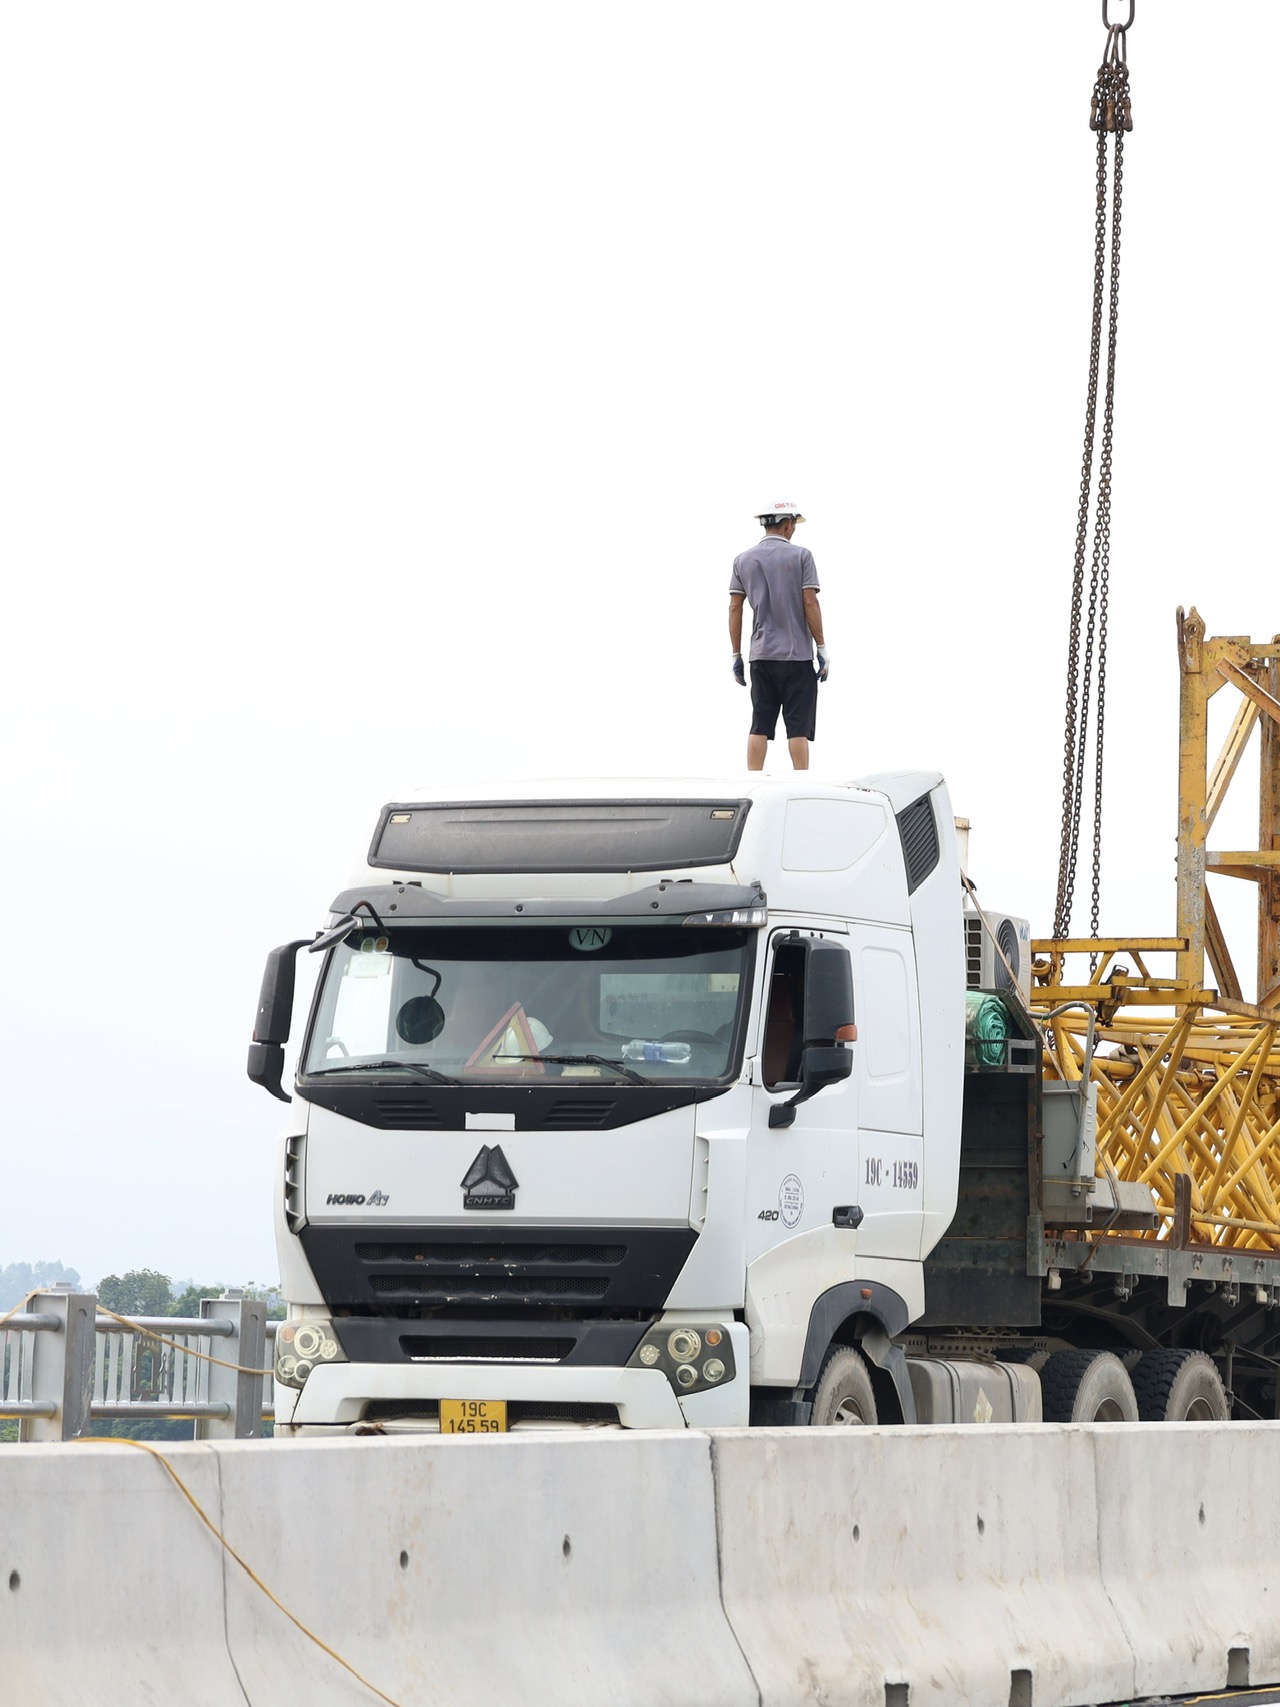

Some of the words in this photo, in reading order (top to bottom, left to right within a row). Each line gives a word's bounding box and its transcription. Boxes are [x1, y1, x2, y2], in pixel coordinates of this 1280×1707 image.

[576, 929, 607, 945] VN
[865, 1157, 882, 1186] 19C
[893, 1160, 918, 1190] 14559
[326, 1194, 366, 1205] HOWO
[366, 1189, 390, 1206] A7
[758, 1210, 779, 1221] 420
[461, 1401, 487, 1418] 19C
[449, 1419, 499, 1433] 145.59
